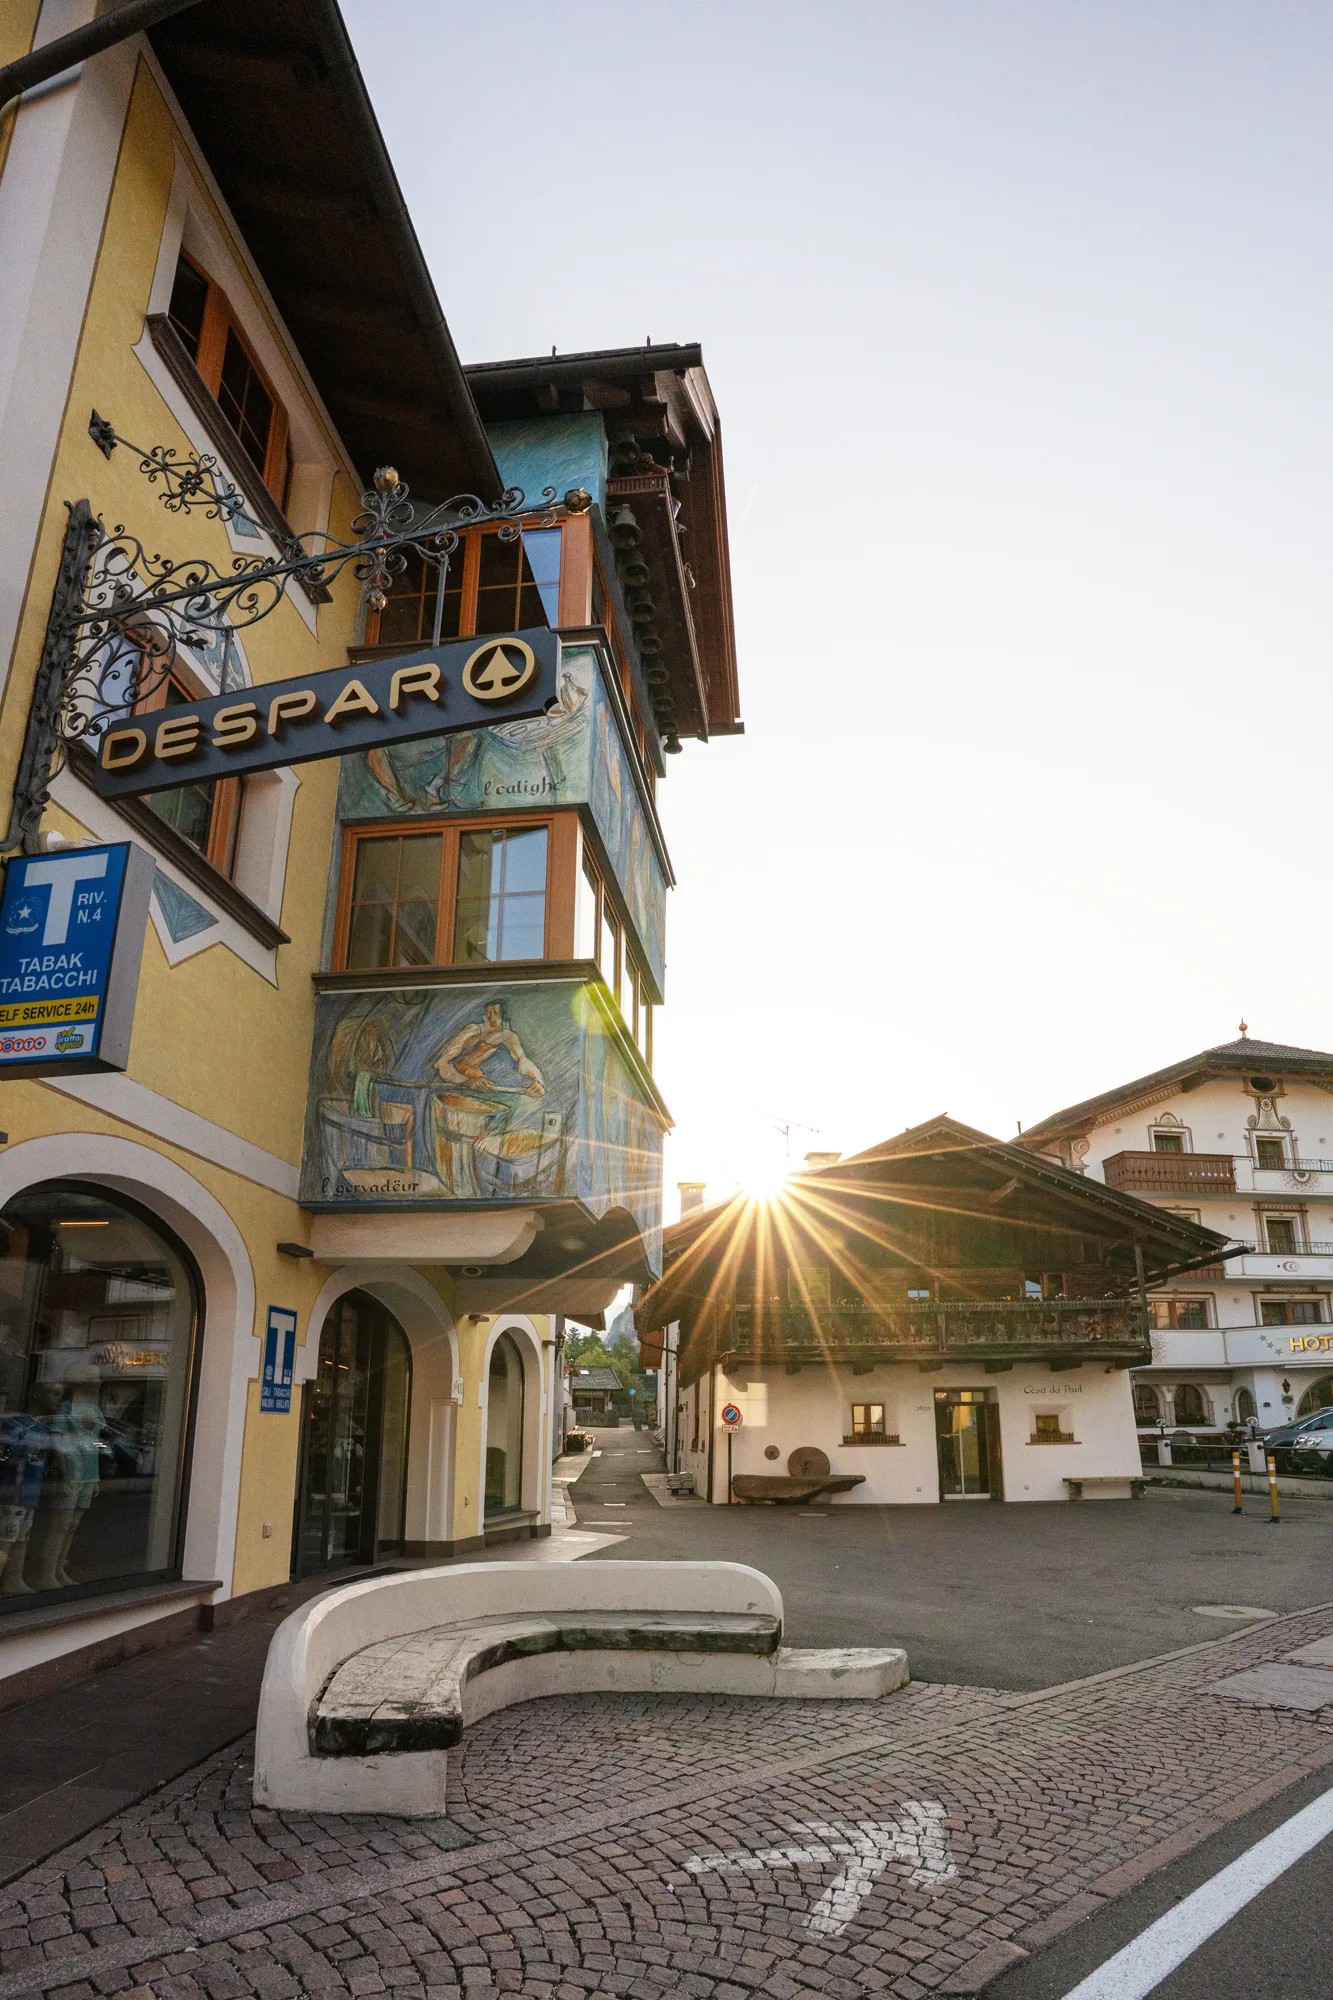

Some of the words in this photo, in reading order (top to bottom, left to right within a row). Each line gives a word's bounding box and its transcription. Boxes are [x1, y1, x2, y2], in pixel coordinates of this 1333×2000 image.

[101, 663, 441, 769] DESPAR
[24, 853, 109, 946] T
[78, 891, 107, 906] RIV.
[20, 952, 84, 974] TABAK
[1, 969, 98, 994] TABACCHI
[0, 1008, 20, 1022] ELF
[22, 1003, 73, 1020] SERVICE
[75, 1001, 95, 1015] 24h
[0, 1037, 45, 1052] OTTO
[333, 1179, 420, 1197] gervadëur
[1289, 1335, 1333, 1352] HOT
[1050, 1385, 1061, 1394] da
[1064, 1384, 1083, 1394] Paul
